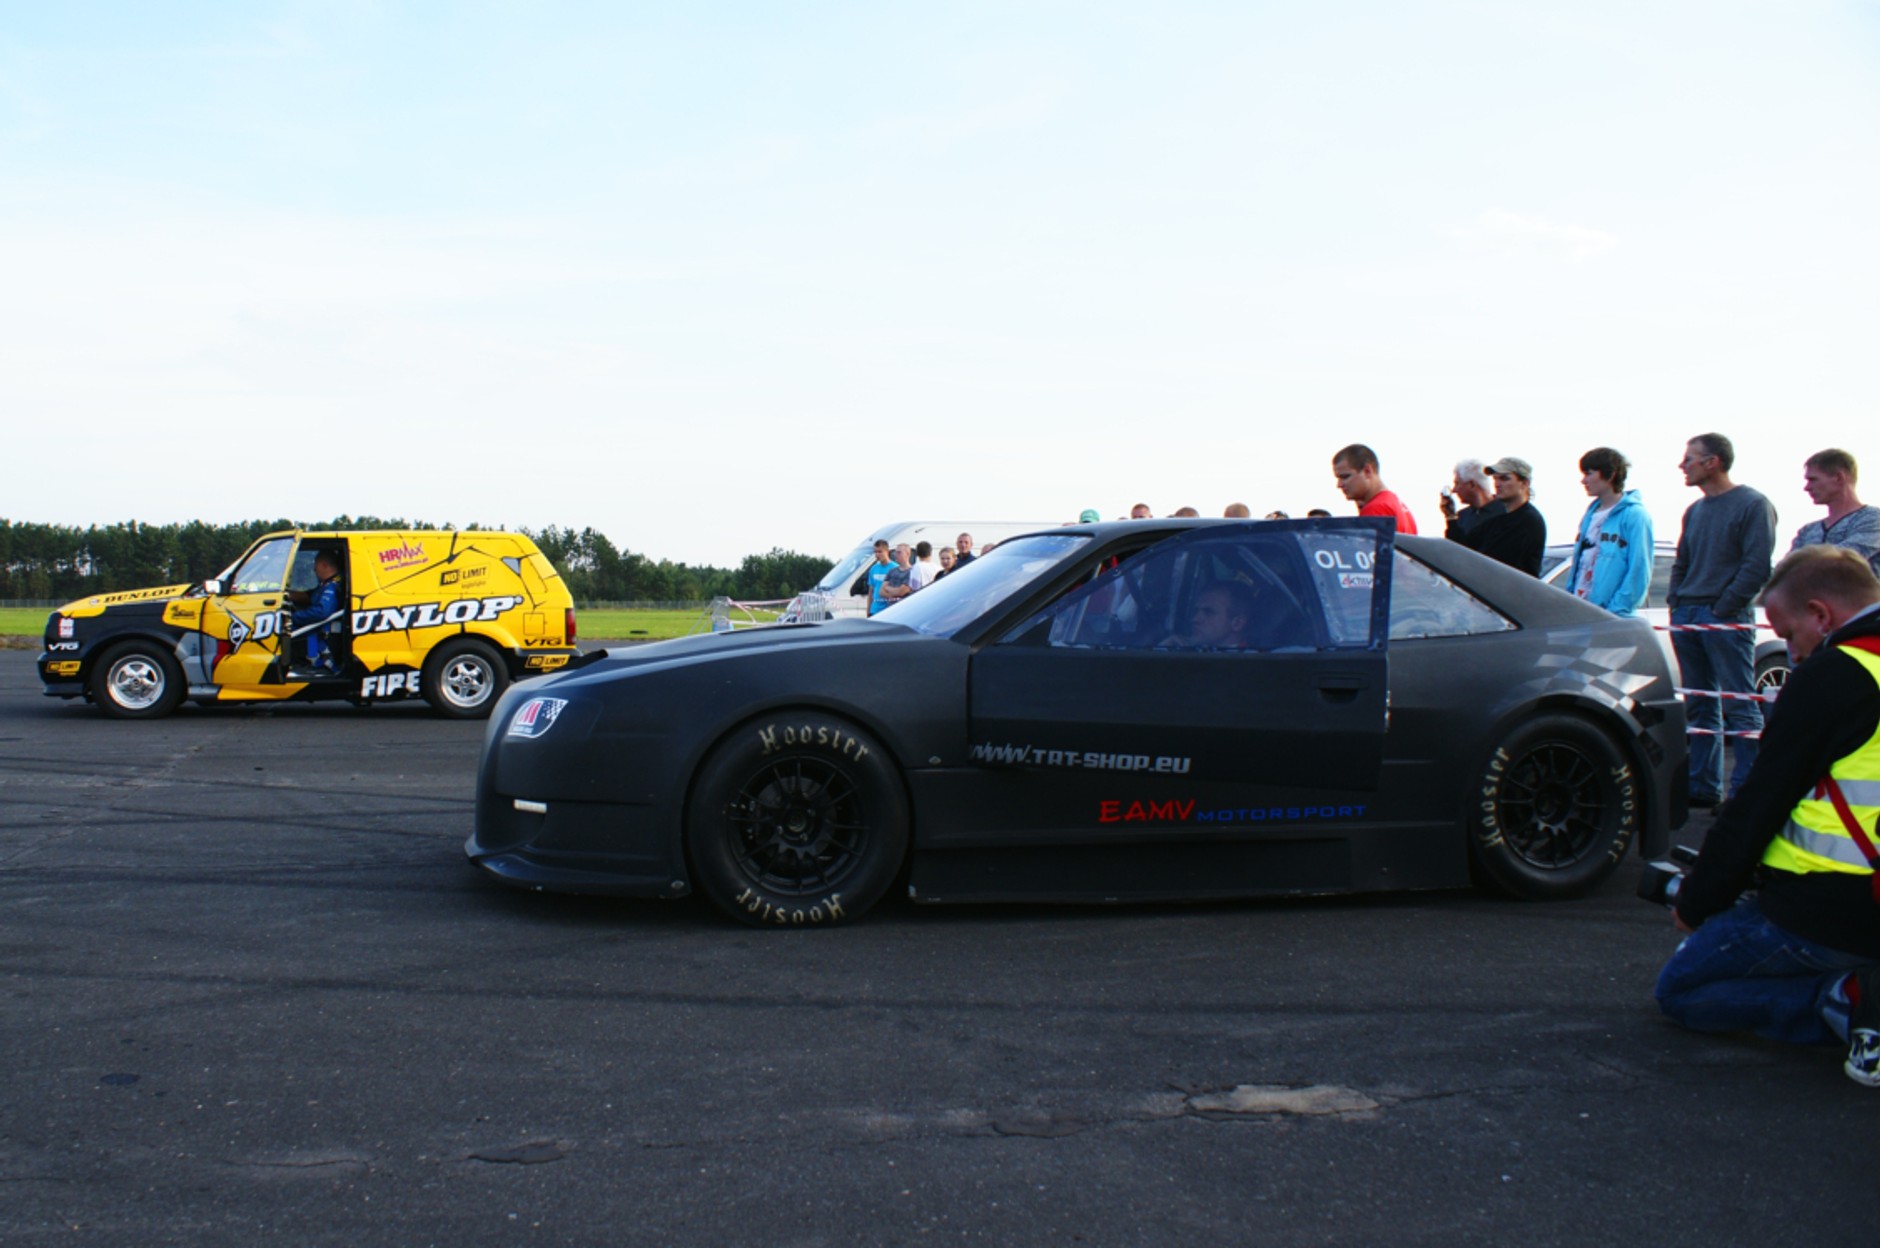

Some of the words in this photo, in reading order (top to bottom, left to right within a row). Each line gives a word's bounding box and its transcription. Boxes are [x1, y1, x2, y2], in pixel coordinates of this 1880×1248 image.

[1314, 549, 1352, 569] OL
[462, 566, 487, 580] LIMIT
[103, 587, 178, 604] DUNLOP
[360, 670, 421, 698] FIRE
[758, 723, 869, 762] Hoosier
[1098, 799, 1195, 824] EAMV
[1196, 804, 1368, 822] MOTORSPORT
